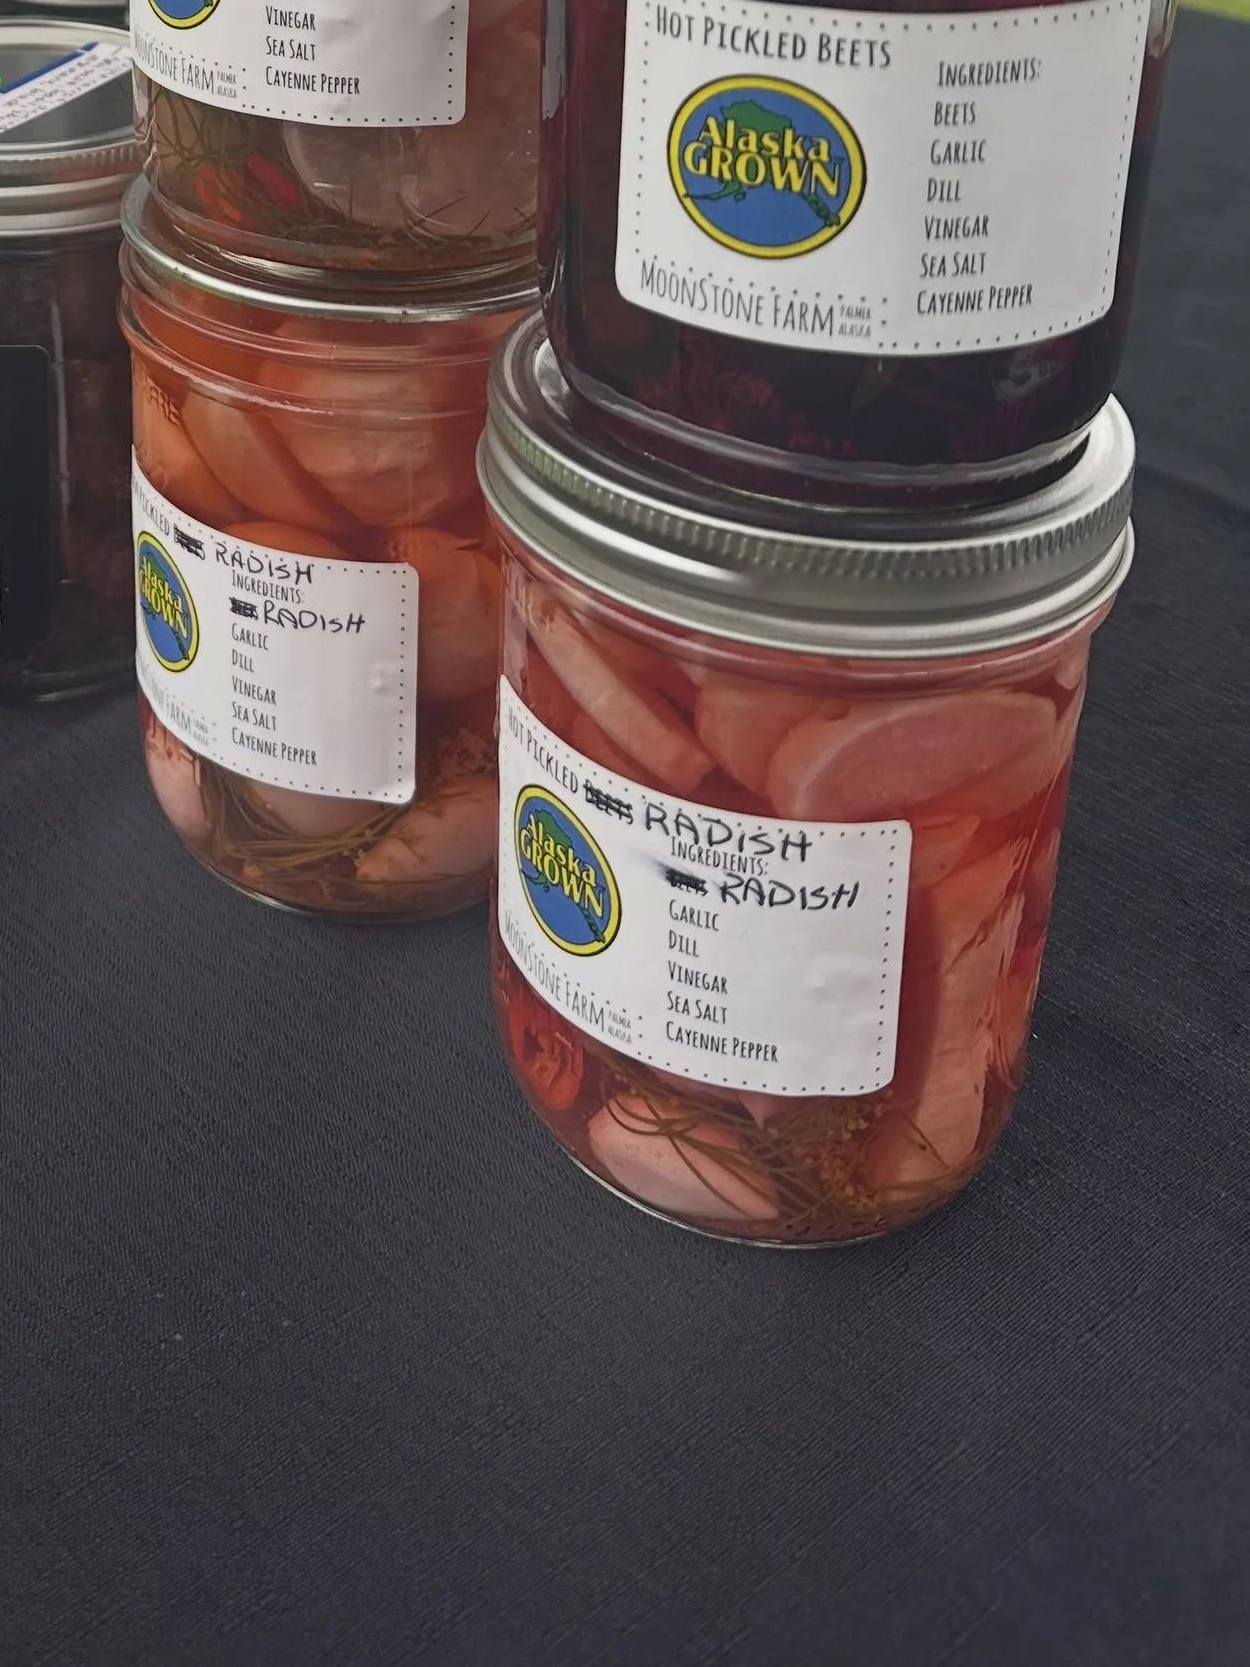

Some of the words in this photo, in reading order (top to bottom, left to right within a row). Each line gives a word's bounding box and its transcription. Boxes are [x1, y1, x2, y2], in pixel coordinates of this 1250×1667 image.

[265, 6, 316, 32] VINEGAR
[655, 4, 695, 45] HOT
[703, 19, 808, 62] PICKLED
[817, 32, 892, 68] BEETS
[265, 36, 286, 58] SEA
[289, 38, 316, 63] SALT
[181, 57, 215, 95] FARM
[265, 66, 317, 93] CAYENNE
[320, 75, 361, 95] PEPPER
[937, 58, 1042, 89] INGREDIENTS:
[933, 102, 977, 127] BEETS
[697, 115, 830, 162] Alaska
[930, 140, 987, 166] GARLIC
[683, 142, 842, 198] GROWN
[927, 179, 962, 203] DILL
[924, 214, 990, 241] VINEGAR
[920, 252, 949, 279] SEA
[952, 251, 987, 276] SALT
[640, 259, 765, 326] MOONSTONE
[772, 294, 835, 337] FARM
[916, 288, 984, 316] CAYENNE
[989, 283, 1034, 311] PEPPER
[215, 542, 314, 584] RADISH
[231, 569, 305, 605] INGREDIENTS:
[263, 600, 366, 634] RADISH
[231, 622, 269, 652] GARLIC
[231, 649, 254, 674] DILL
[231, 675, 277, 706] VINEGAR
[231, 701, 250, 724] SEA
[252, 707, 277, 732] SALT
[231, 726, 278, 758] CAYENNE
[281, 742, 317, 767] PEPPER
[509, 703, 525, 745] HOT
[527, 729, 579, 794] PICKLED
[645, 801, 813, 863] RADISH
[521, 813, 597, 890] Alaska
[670, 835, 769, 877] INGREDIENTS:
[519, 827, 606, 919] GROWN
[719, 871, 860, 910] RADISH
[668, 899, 720, 931] GARLIC
[668, 929, 699, 958] DILL
[667, 960, 729, 995] VINEGAR
[565, 979, 605, 1033] FARM
[666, 990, 691, 1018] SEA
[694, 998, 728, 1026] SALT
[665, 1021, 728, 1056] CAYENNE
[732, 1035, 779, 1064] PEPPER
